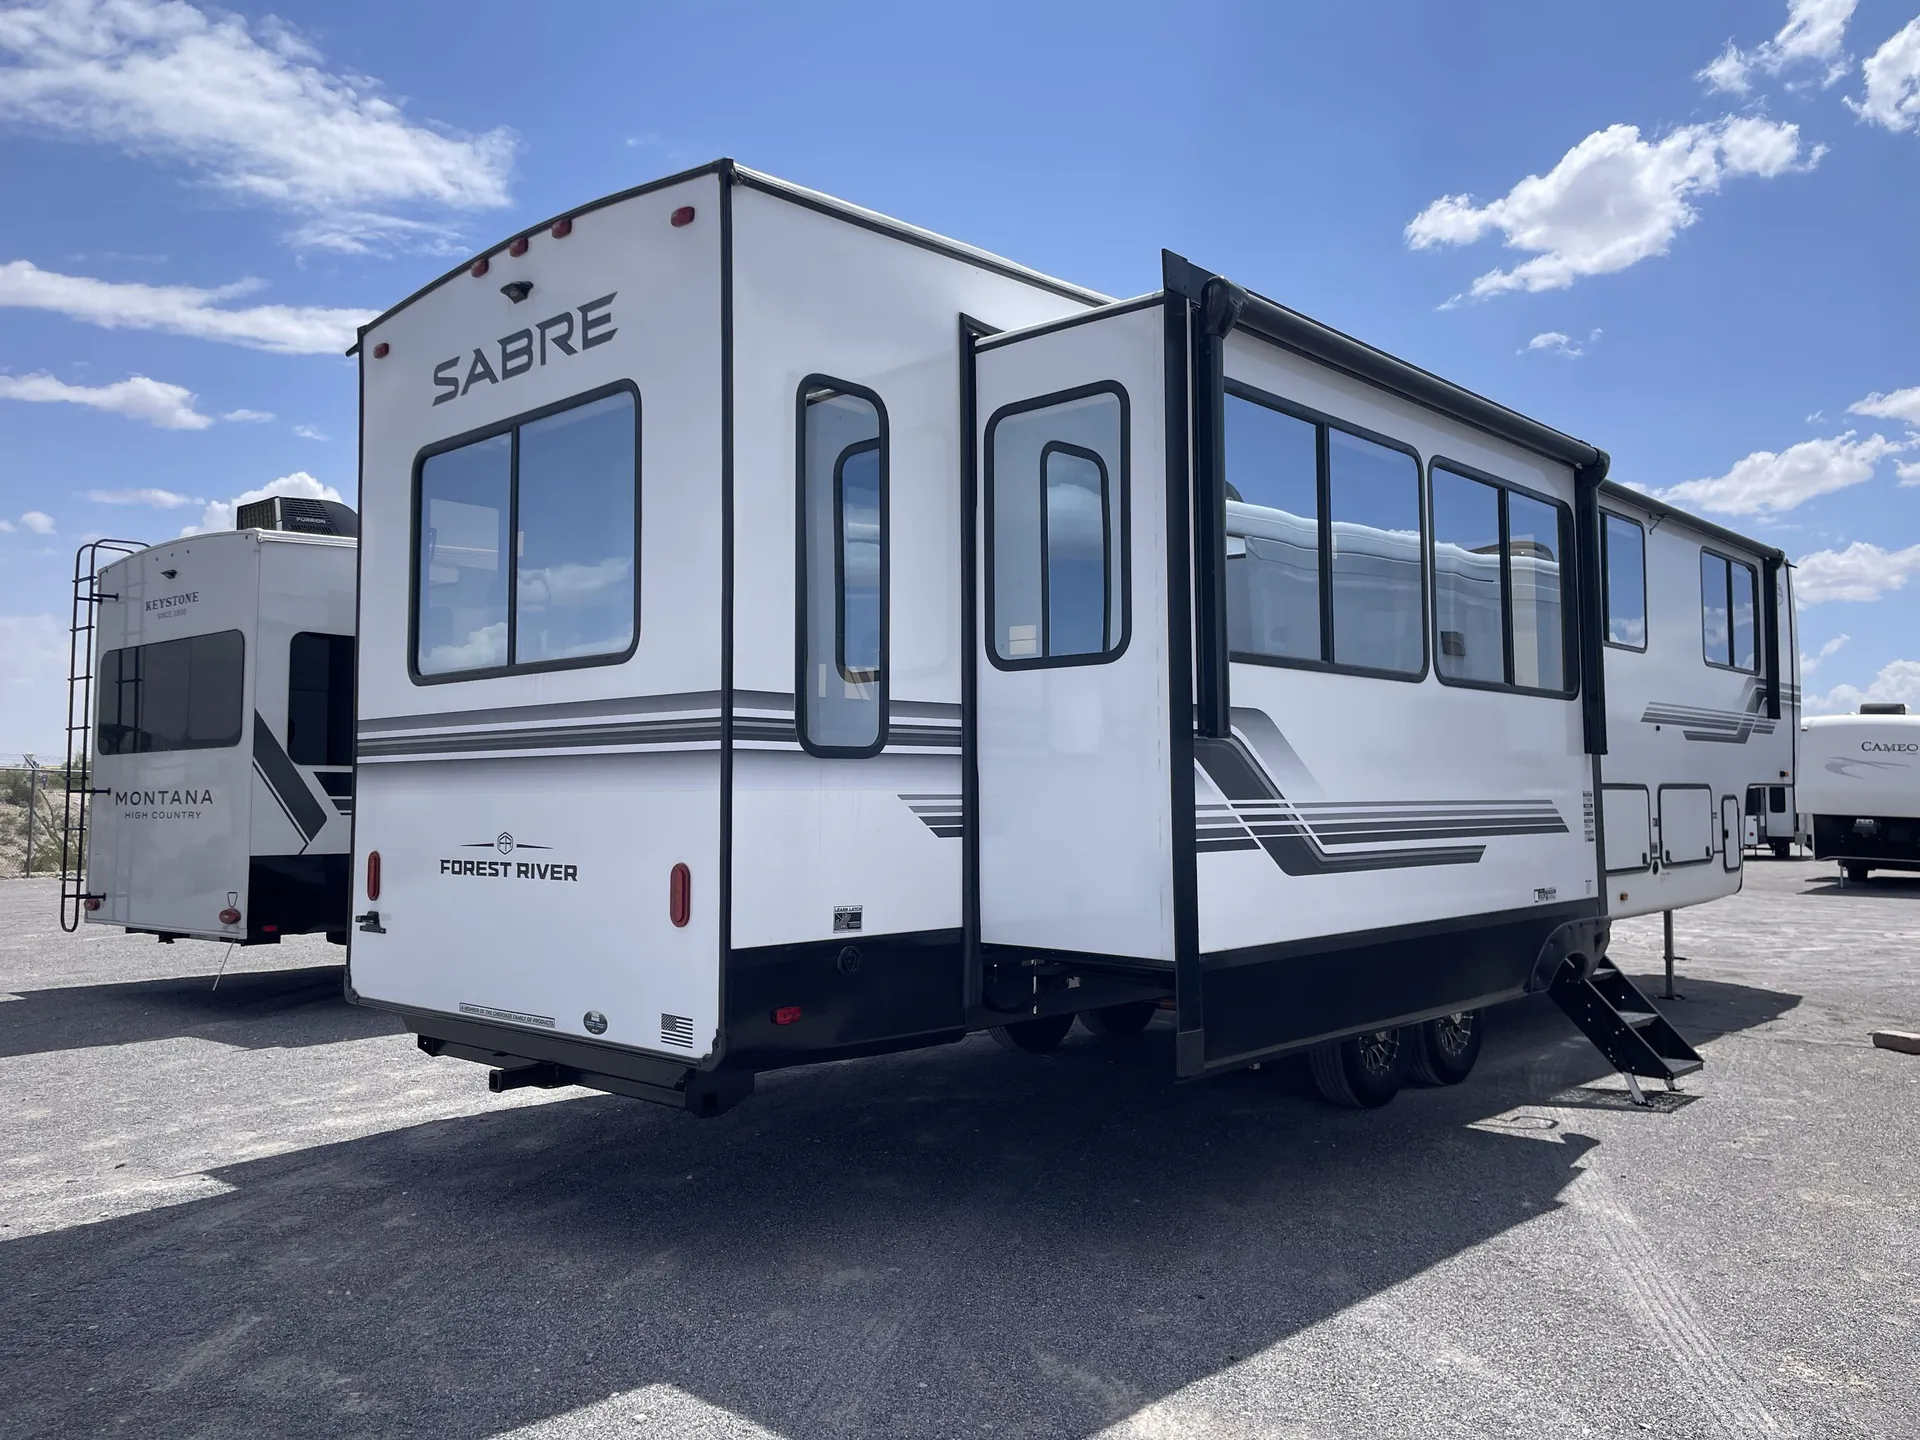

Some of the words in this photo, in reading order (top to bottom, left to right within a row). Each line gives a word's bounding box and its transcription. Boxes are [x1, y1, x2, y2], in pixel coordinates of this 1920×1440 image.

[432, 291, 619, 407] SABRE
[145, 591, 200, 611] KEYSTONE
[157, 610, 173, 620] SINCE
[1861, 741, 1919, 752] CAMEO
[115, 789, 213, 806] MONTANA
[124, 811, 148, 819] HIGH
[151, 811, 202, 819] COUNTRY
[440, 859, 512, 877] FOREST
[516, 862, 578, 881] RIVER
